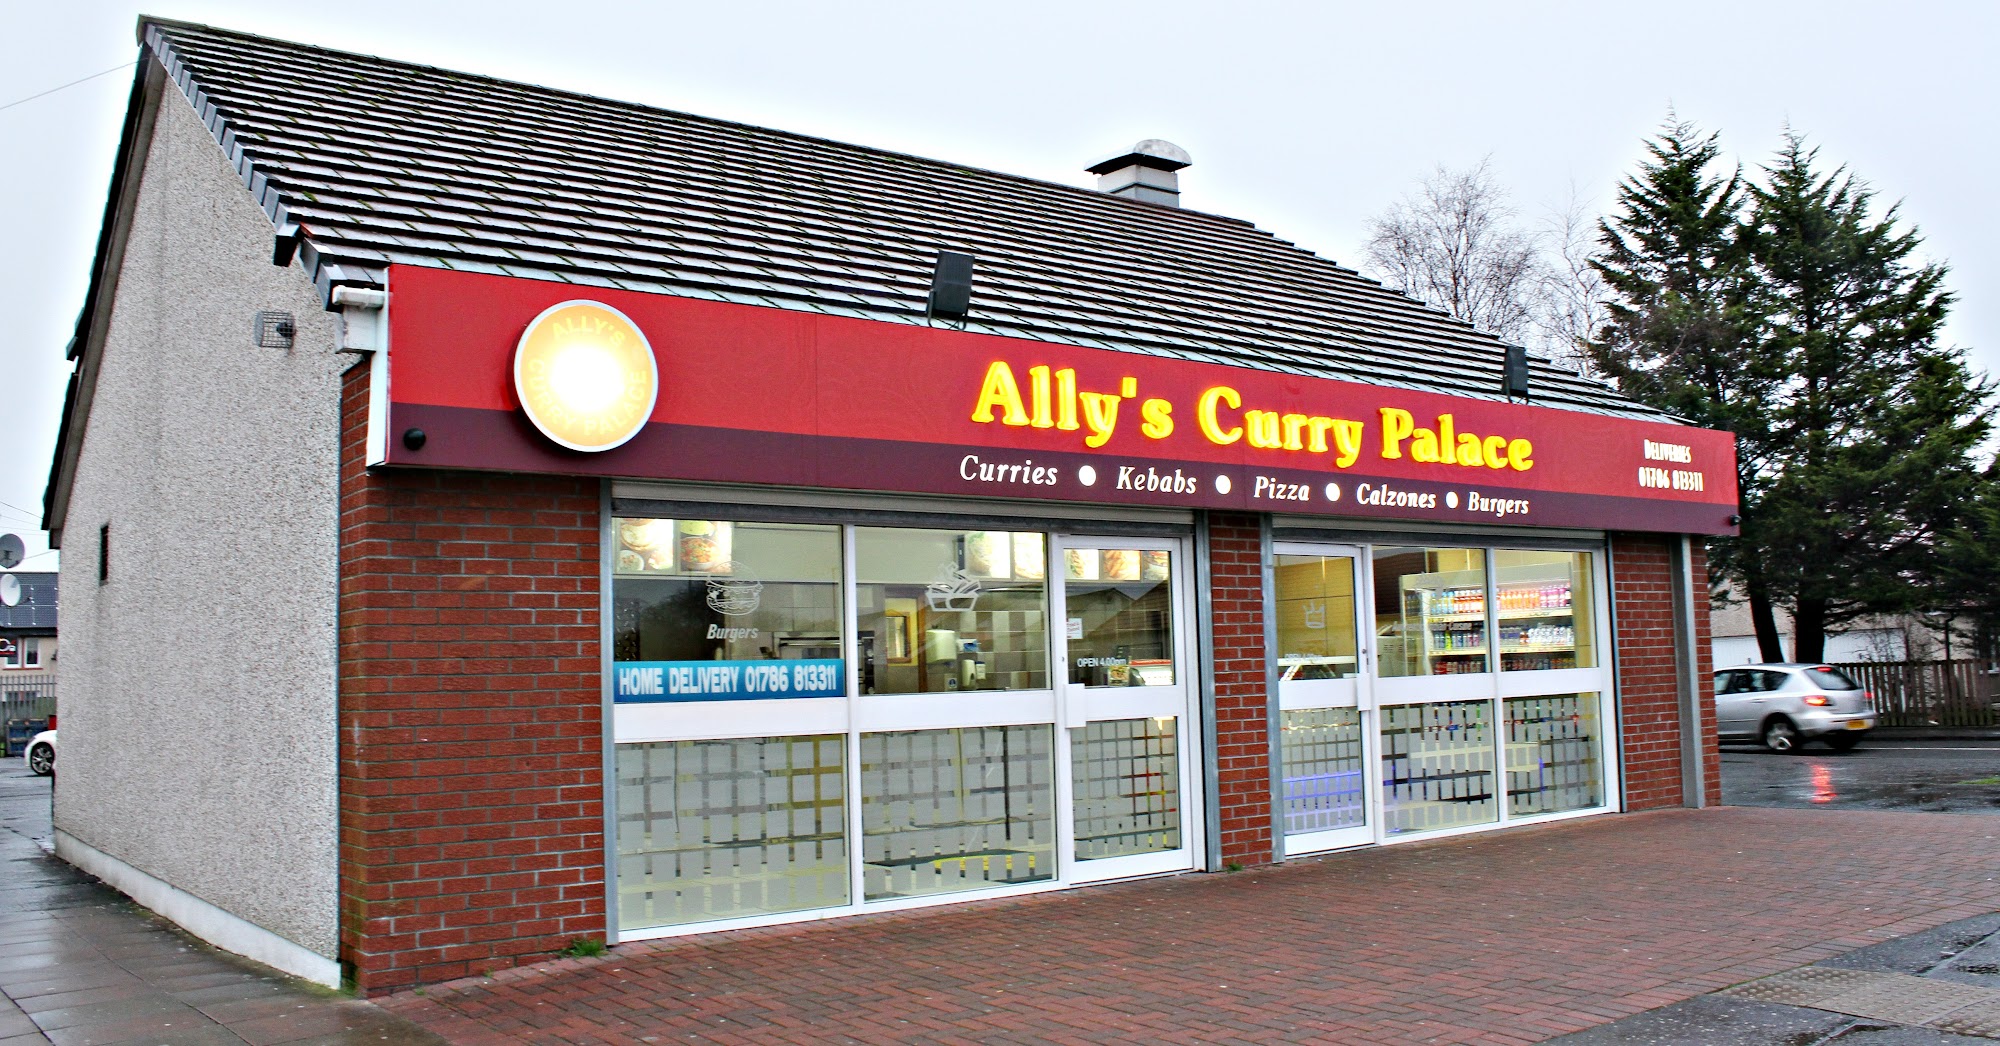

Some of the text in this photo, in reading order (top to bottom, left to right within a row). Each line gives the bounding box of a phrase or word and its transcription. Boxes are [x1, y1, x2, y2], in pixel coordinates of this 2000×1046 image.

[527, 358, 648, 437] CURRY PALACE
[971, 360, 1534, 472] Ally's Curry Palace
[959, 454, 1530, 518] Curries Kebabs Pizza Calzones Burgers
[706, 624, 759, 642] Burgers
[619, 664, 837, 696] HOME DELIVERY 01786 813311
[1077, 657, 1099, 668] OPEN
